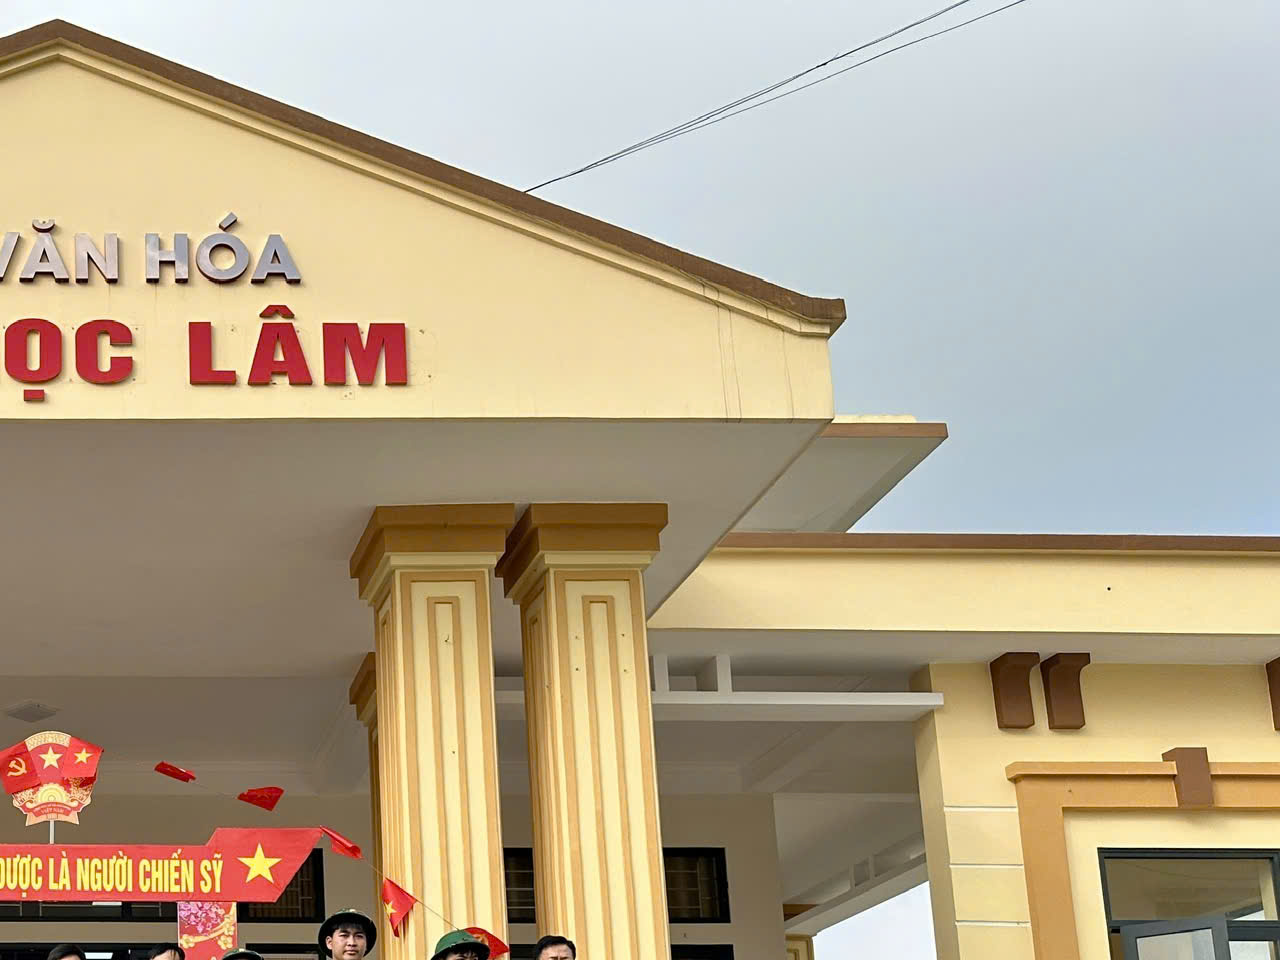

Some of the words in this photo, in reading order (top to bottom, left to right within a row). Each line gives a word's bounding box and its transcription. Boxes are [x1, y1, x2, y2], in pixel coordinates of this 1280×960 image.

[145, 212, 303, 285] HÓA
[189, 304, 408, 387] LÂM
[48, 851, 71, 891] LÀ
[76, 850, 133, 892] NGƯỜI
[138, 849, 195, 893] CHIẾN
[199, 853, 223, 893] SỸ
